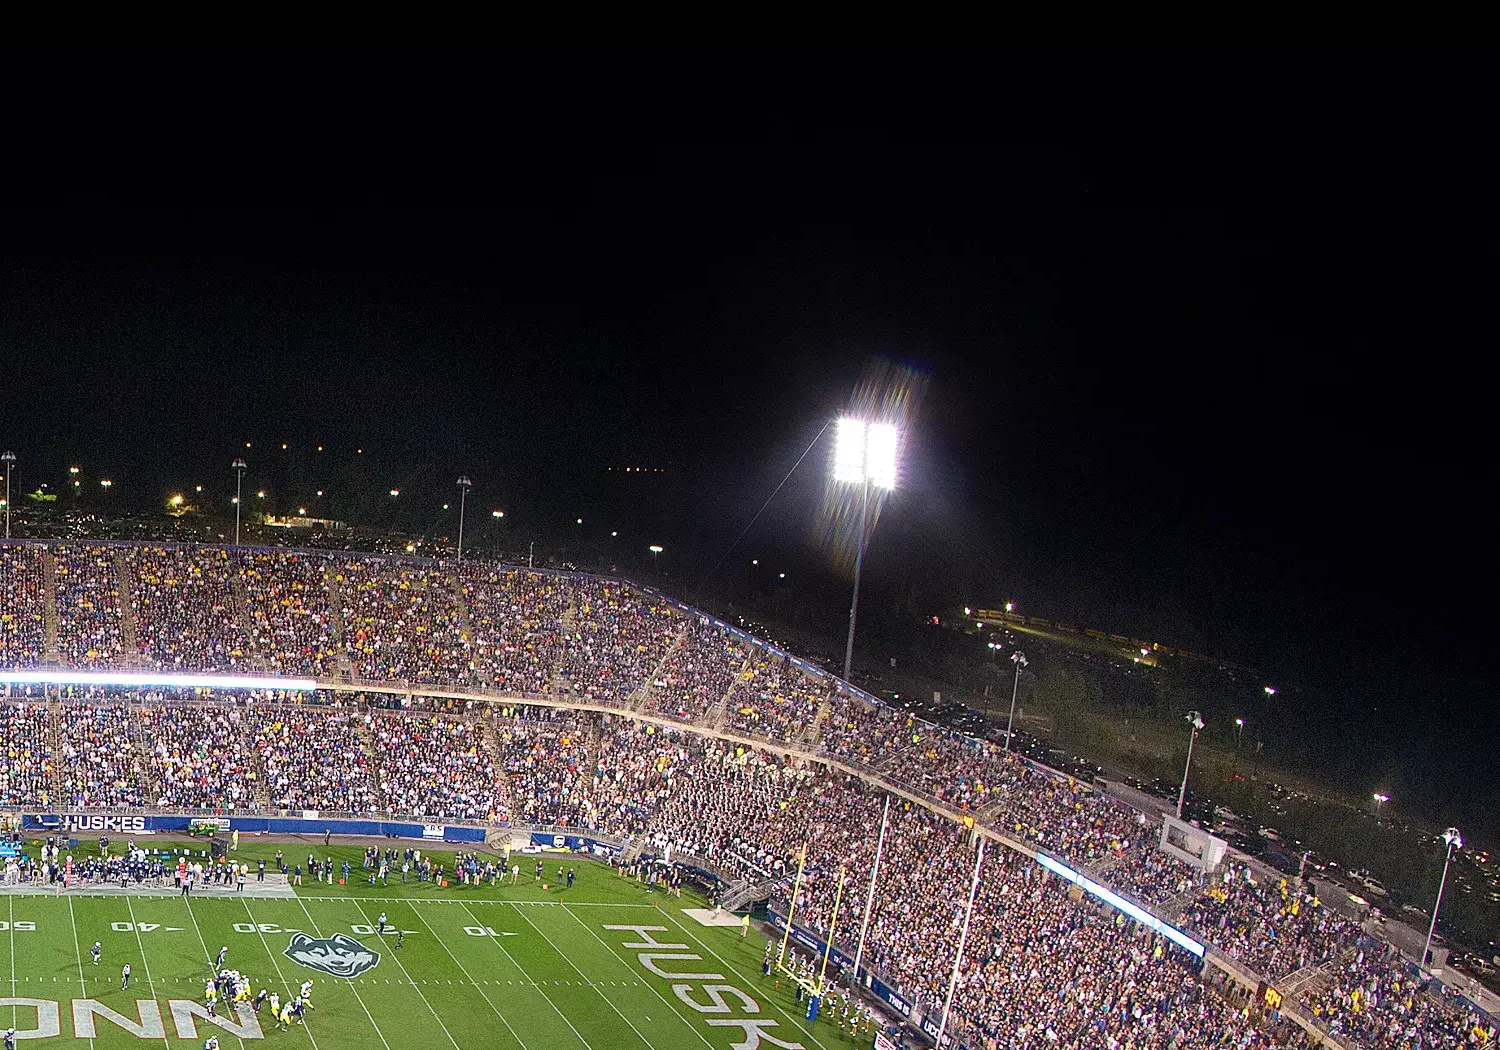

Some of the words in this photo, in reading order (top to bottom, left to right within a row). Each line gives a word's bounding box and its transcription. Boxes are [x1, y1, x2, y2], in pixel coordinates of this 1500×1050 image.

[111, 922, 161, 932] 40
[233, 923, 282, 933] 30
[889, 993, 902, 1008] THIS
[900, 1002, 911, 1016] IS
